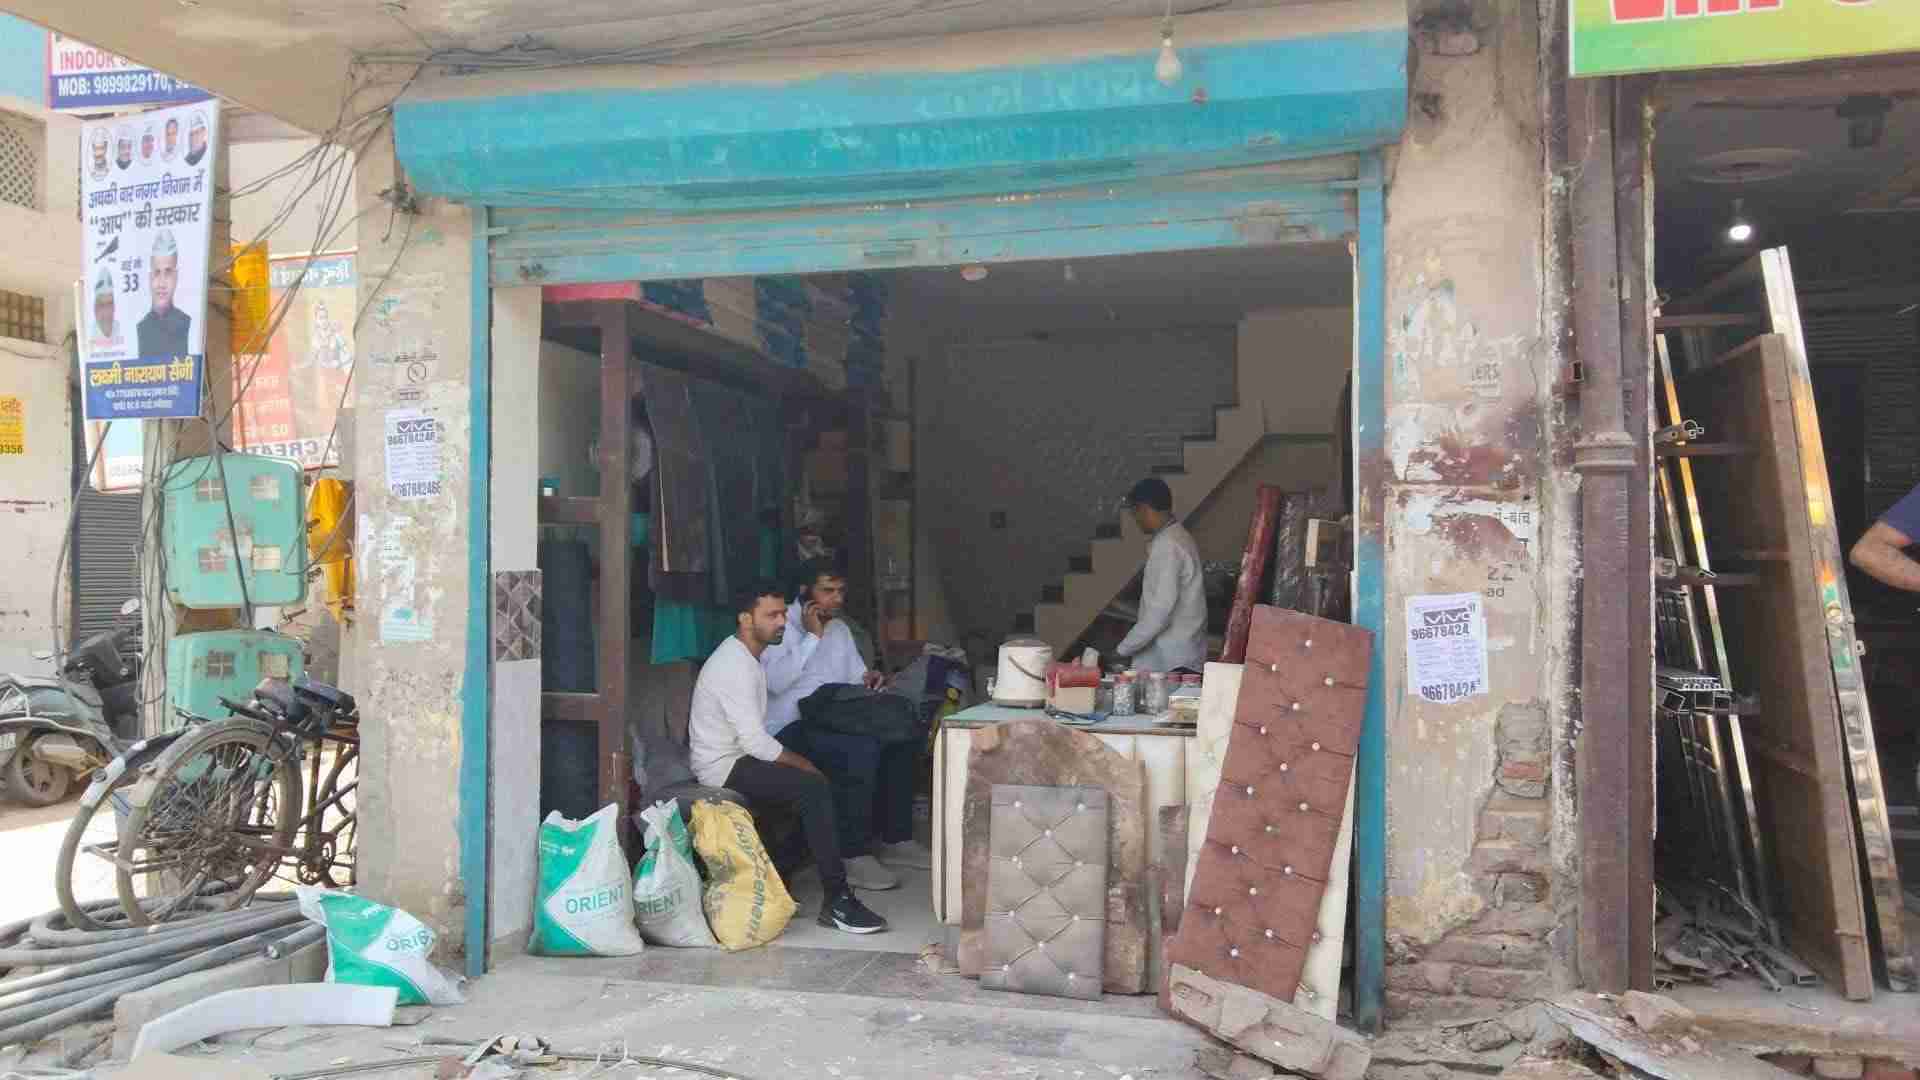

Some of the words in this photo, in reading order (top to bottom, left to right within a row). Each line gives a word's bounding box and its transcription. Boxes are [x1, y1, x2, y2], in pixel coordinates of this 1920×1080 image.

[58, 77, 91, 97] MOB:
[134, 201, 153, 228] की
[155, 203, 202, 227] सरकार
[122, 273, 139, 293] 33
